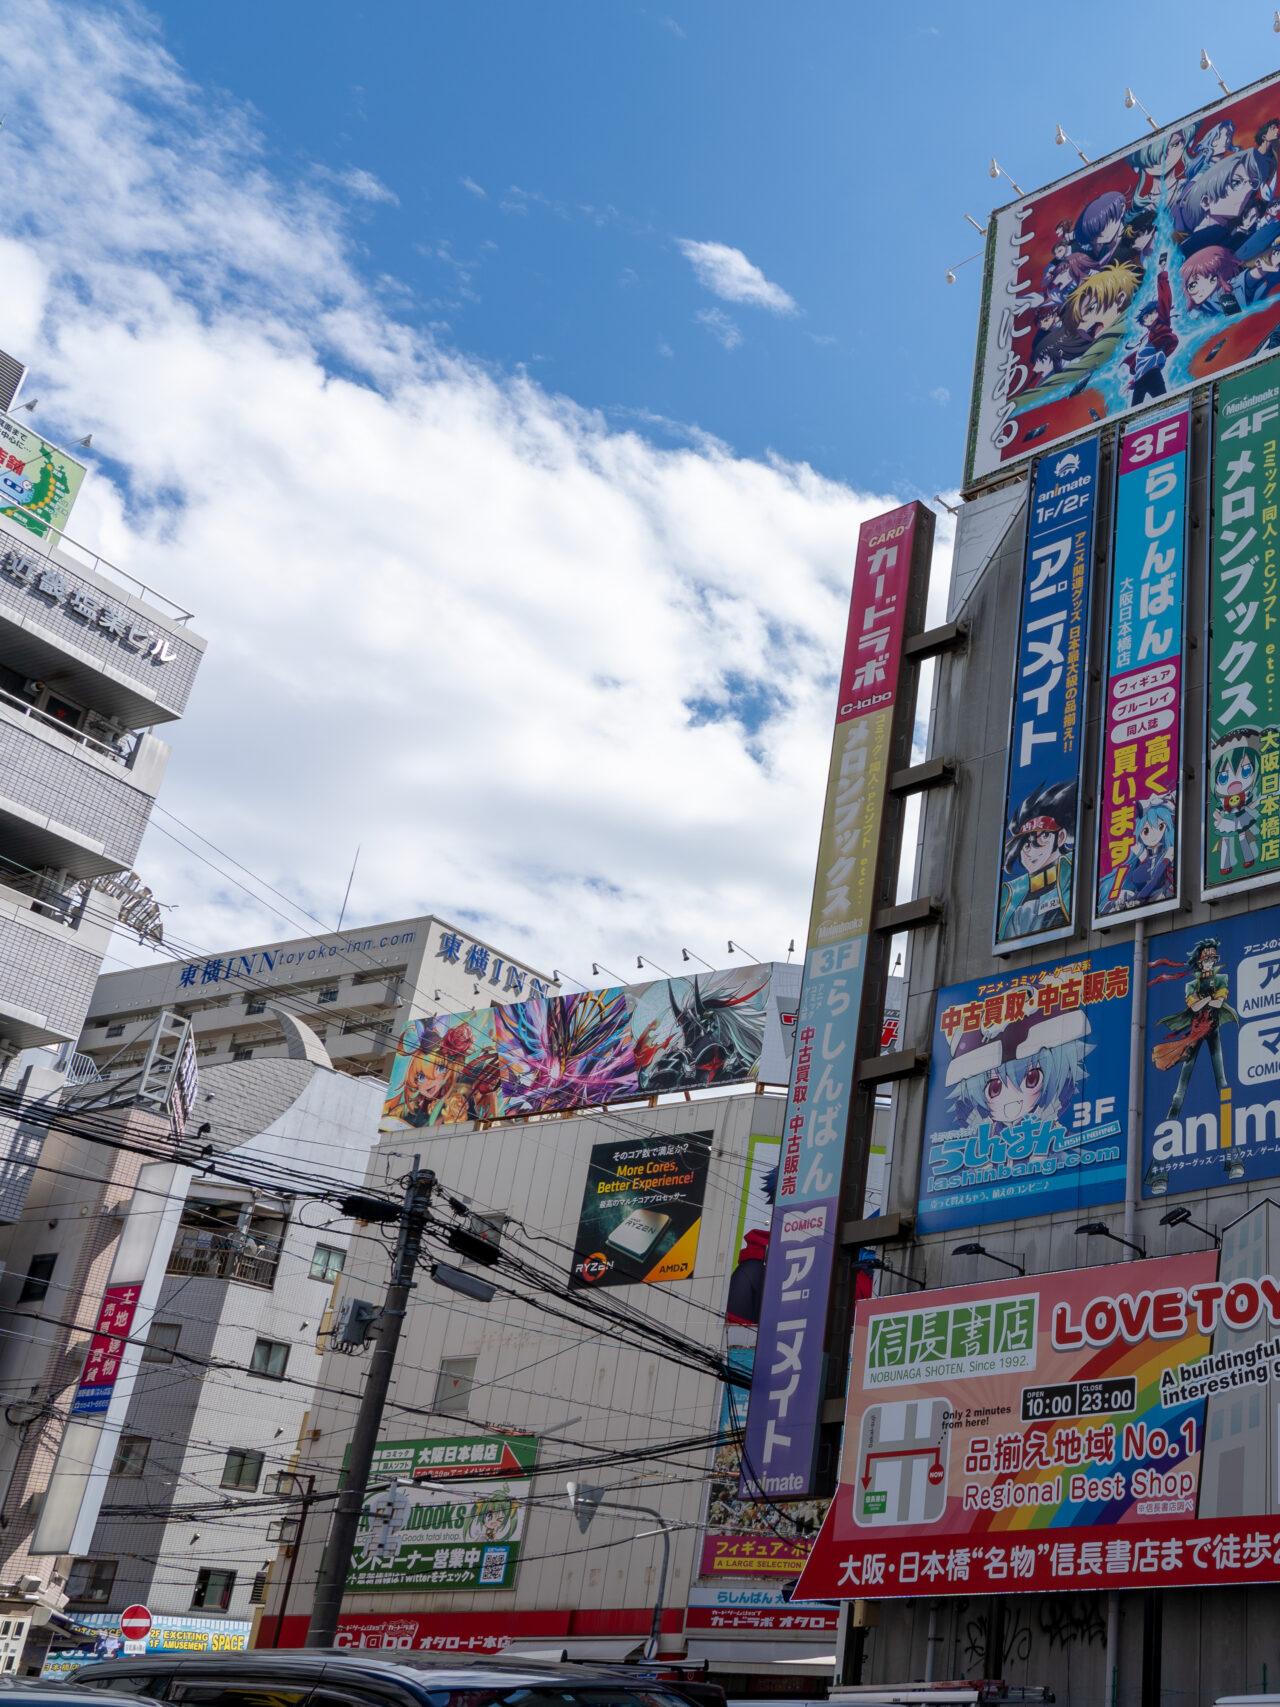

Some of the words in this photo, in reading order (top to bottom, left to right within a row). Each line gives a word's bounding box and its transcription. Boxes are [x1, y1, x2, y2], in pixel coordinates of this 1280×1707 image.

[990, 206, 1037, 449] ここにある
[1226, 387, 1279, 416] Melonbooks
[1220, 403, 1279, 441] 4F
[1129, 421, 1180, 463] 3F
[1037, 474, 1092, 503] animate
[1036, 493, 1090, 524] 1F/2F
[868, 526, 905, 548] CARD
[1137, 461, 1178, 661] らしんばん
[1070, 531, 1087, 622] アニメ関連グッズ
[1217, 450, 1260, 726] メロンブックス
[852, 545, 898, 691] カードラボ
[1116, 577, 1134, 668] 大阪日本橋店
[1020, 536, 1072, 767] アニメイト
[1119, 669, 1171, 694] フィギュア
[840, 690, 892, 716] C-labo
[1118, 691, 1170, 717] ブルーレイ
[1127, 717, 1158, 737] 同人誌
[1145, 735, 1171, 793] 高く
[1260, 731, 1280, 862] 大阪日本橋店
[820, 720, 870, 916] メロンブックス
[279, 931, 416, 966] toyoko-inn.com
[820, 944, 854, 973] 3F
[437, 932, 549, 999] 東横INN
[802, 979, 850, 1195] らしんばん
[1073, 1097, 1116, 1128] 3F
[928, 1115, 1067, 1175] らしんばん
[597, 1180, 630, 1194] Better
[632, 1171, 694, 1190] Experience!
[616, 1164, 644, 1177] More
[646, 1162, 678, 1174] Cores,
[927, 1146, 1120, 1192] lashinbang.com
[625, 1220, 656, 1234] RYZEN
[784, 1216, 823, 1233] COMICS
[575, 1260, 614, 1273] RYZEN
[659, 1263, 680, 1273] AMD
[869, 1302, 1034, 1368] 信長書店
[762, 1246, 815, 1464] アニメイト
[870, 1368, 922, 1384] NOBUNAGA
[969, 1358, 996, 1373] Since
[1000, 1355, 1030, 1369] 1992.
[1082, 1384, 1103, 1392] CLOSE
[1161, 1371, 1175, 1388] A
[1163, 1364, 1268, 1406] interesting
[1027, 1391, 1045, 1399] OPEN
[1027, 1396, 1072, 1417] 10:00
[1081, 1390, 1132, 1412] 23:00
[942, 1419, 962, 1430] from
[965, 1416, 989, 1428] here!
[943, 1409, 963, 1422] Only
[966, 1408, 972, 1418] 2
[974, 1405, 1011, 1417] minutes
[418, 1444, 498, 1463] 大阪日本橋店
[965, 1428, 1114, 1475] 品揃え地域
[1124, 1418, 1197, 1461] No.1
[742, 1471, 804, 1494] animate
[929, 1470, 944, 1479] NOW
[964, 1477, 1062, 1511] Regional
[1071, 1474, 1124, 1500] Best
[1132, 1468, 1193, 1497] Shop
[717, 1591, 773, 1604] らしんばん
[150, 1630, 160, 1639] 2F
[163, 1630, 209, 1642] EXCITING
[711, 1616, 773, 1627] カードラボ
[779, 1616, 839, 1628] オタロー
[150, 1639, 159, 1648] 1F
[163, 1640, 209, 1651] AMUSEMENT
[211, 1634, 245, 1651] SPACE
[420, 1636, 512, 1650] オタロード本店
